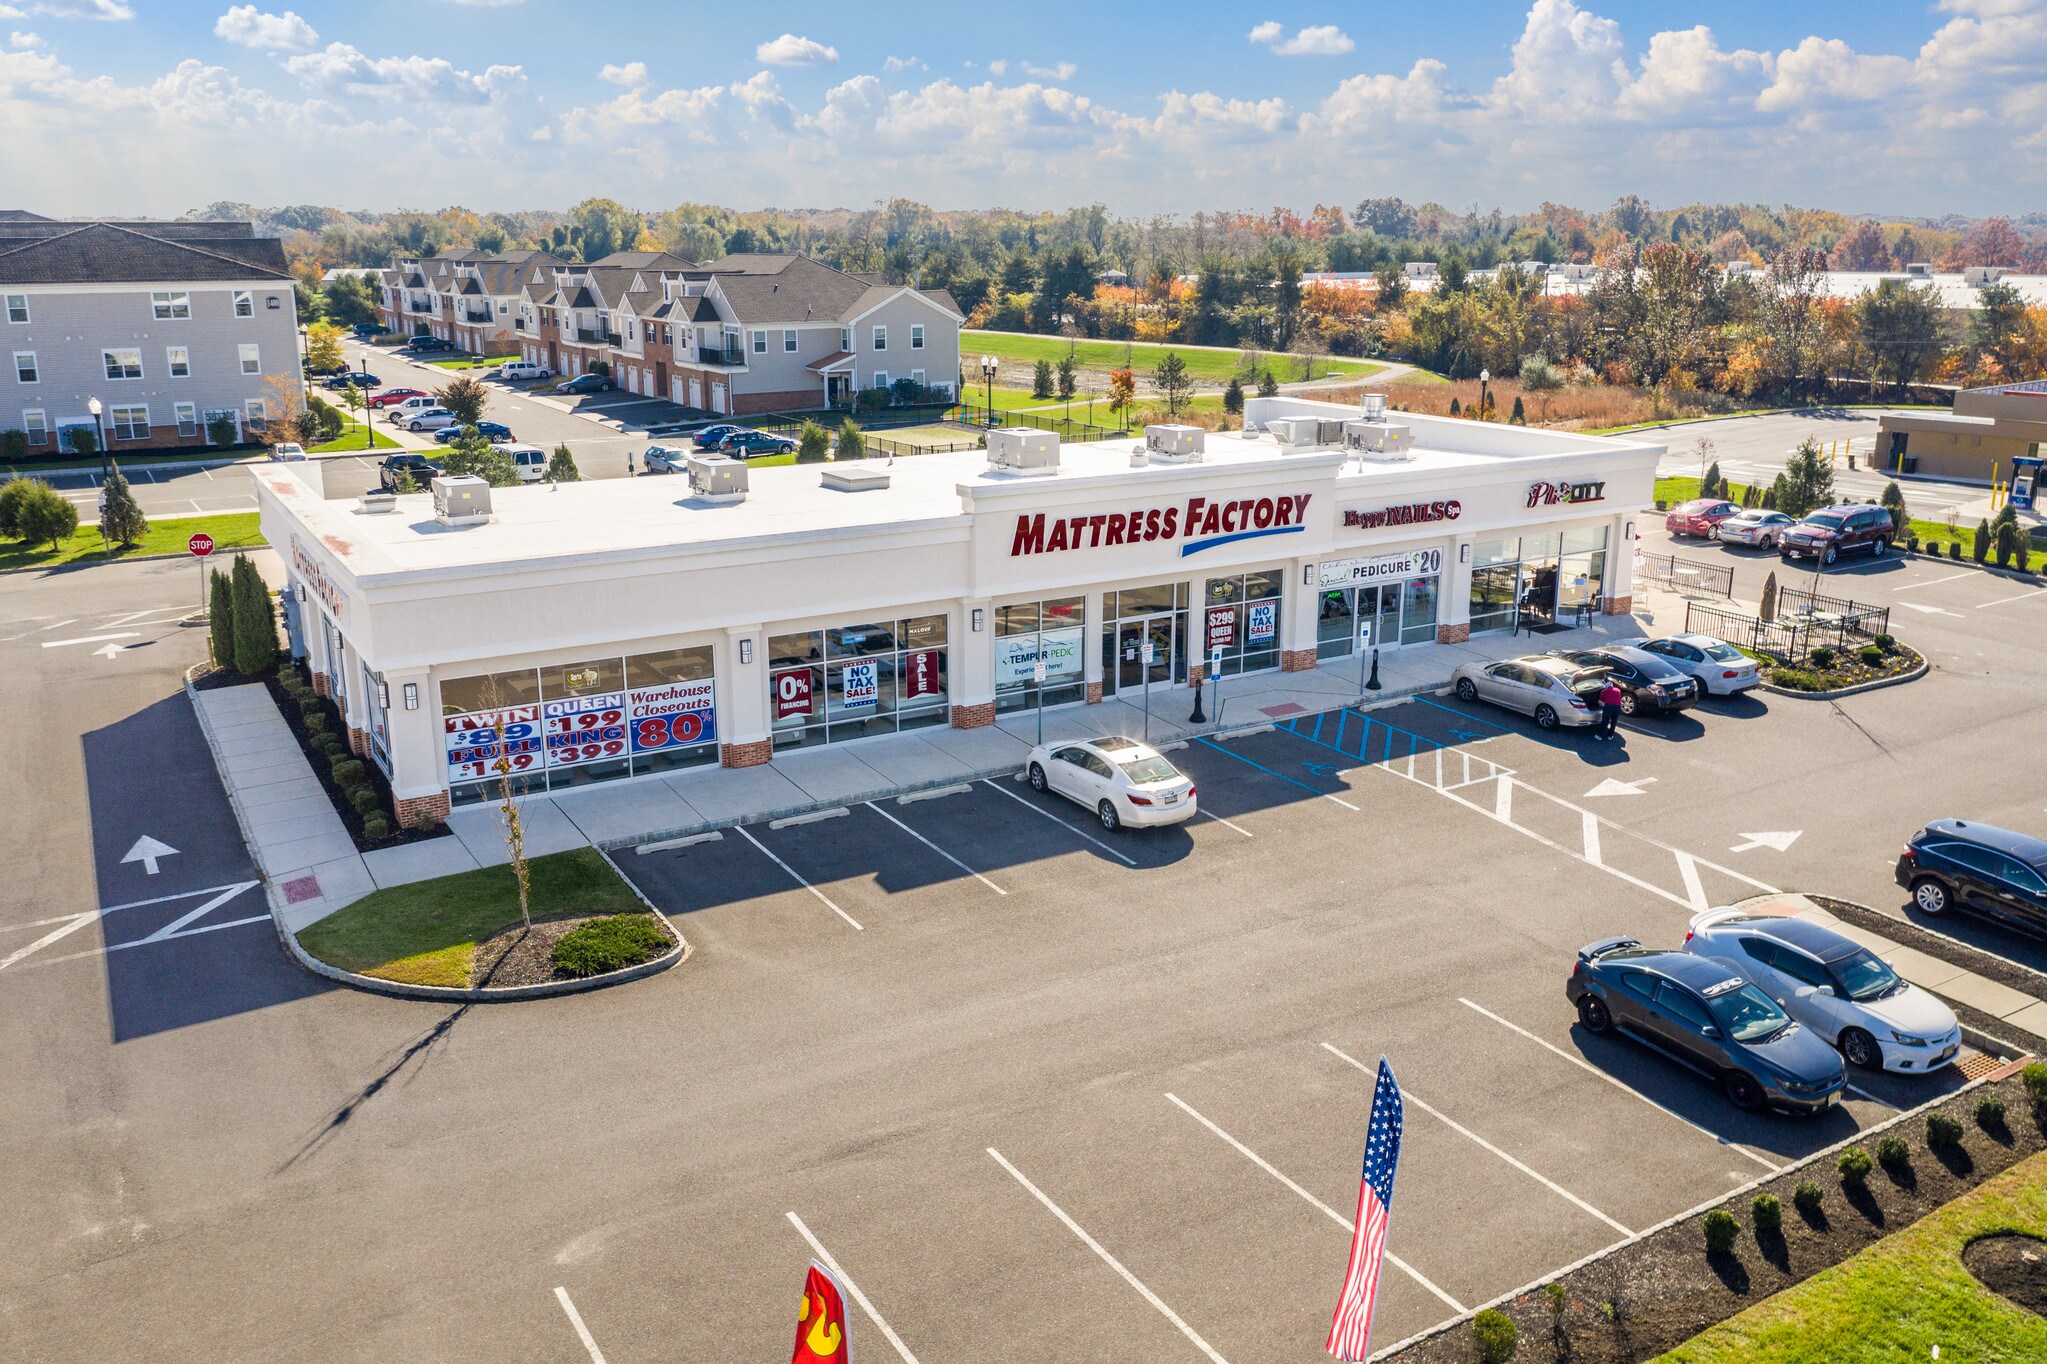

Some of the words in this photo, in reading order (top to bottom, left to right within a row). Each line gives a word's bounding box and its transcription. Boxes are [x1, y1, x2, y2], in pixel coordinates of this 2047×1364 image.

[1571, 481, 1606, 500] CITY
[1344, 510, 1386, 529] Happy
[1386, 501, 1445, 526] NAILS
[1447, 505, 1460, 516] Spa
[1010, 507, 1178, 557] MATTRESS
[1183, 493, 1312, 537] FACTORY
[190, 540, 212, 550] STOP
[1353, 560, 1411, 578] PEDICURE
[1413, 549, 1440, 573] $20
[1209, 610, 1234, 627] $299
[1255, 606, 1270, 617] NO
[1250, 625, 1273, 635] SALE!
[1252, 616, 1272, 627] TAX
[1211, 625, 1232, 638] QUEEN
[850, 665, 870, 678] NO
[916, 653, 928, 692] SALE
[780, 675, 808, 700] 0%
[847, 675, 874, 689] TAX
[630, 685, 711, 704] Warehouse
[846, 686, 876, 698] SALE!
[547, 695, 621, 716] QUEEN
[632, 698, 711, 717] Closeouts
[780, 699, 809, 710] FINANCING
[449, 707, 536, 731] TWIN
[550, 710, 622, 732] $199
[458, 724, 533, 744] $89
[548, 727, 624, 749] KING
[451, 740, 540, 763] FULL
[550, 741, 624, 762] $399
